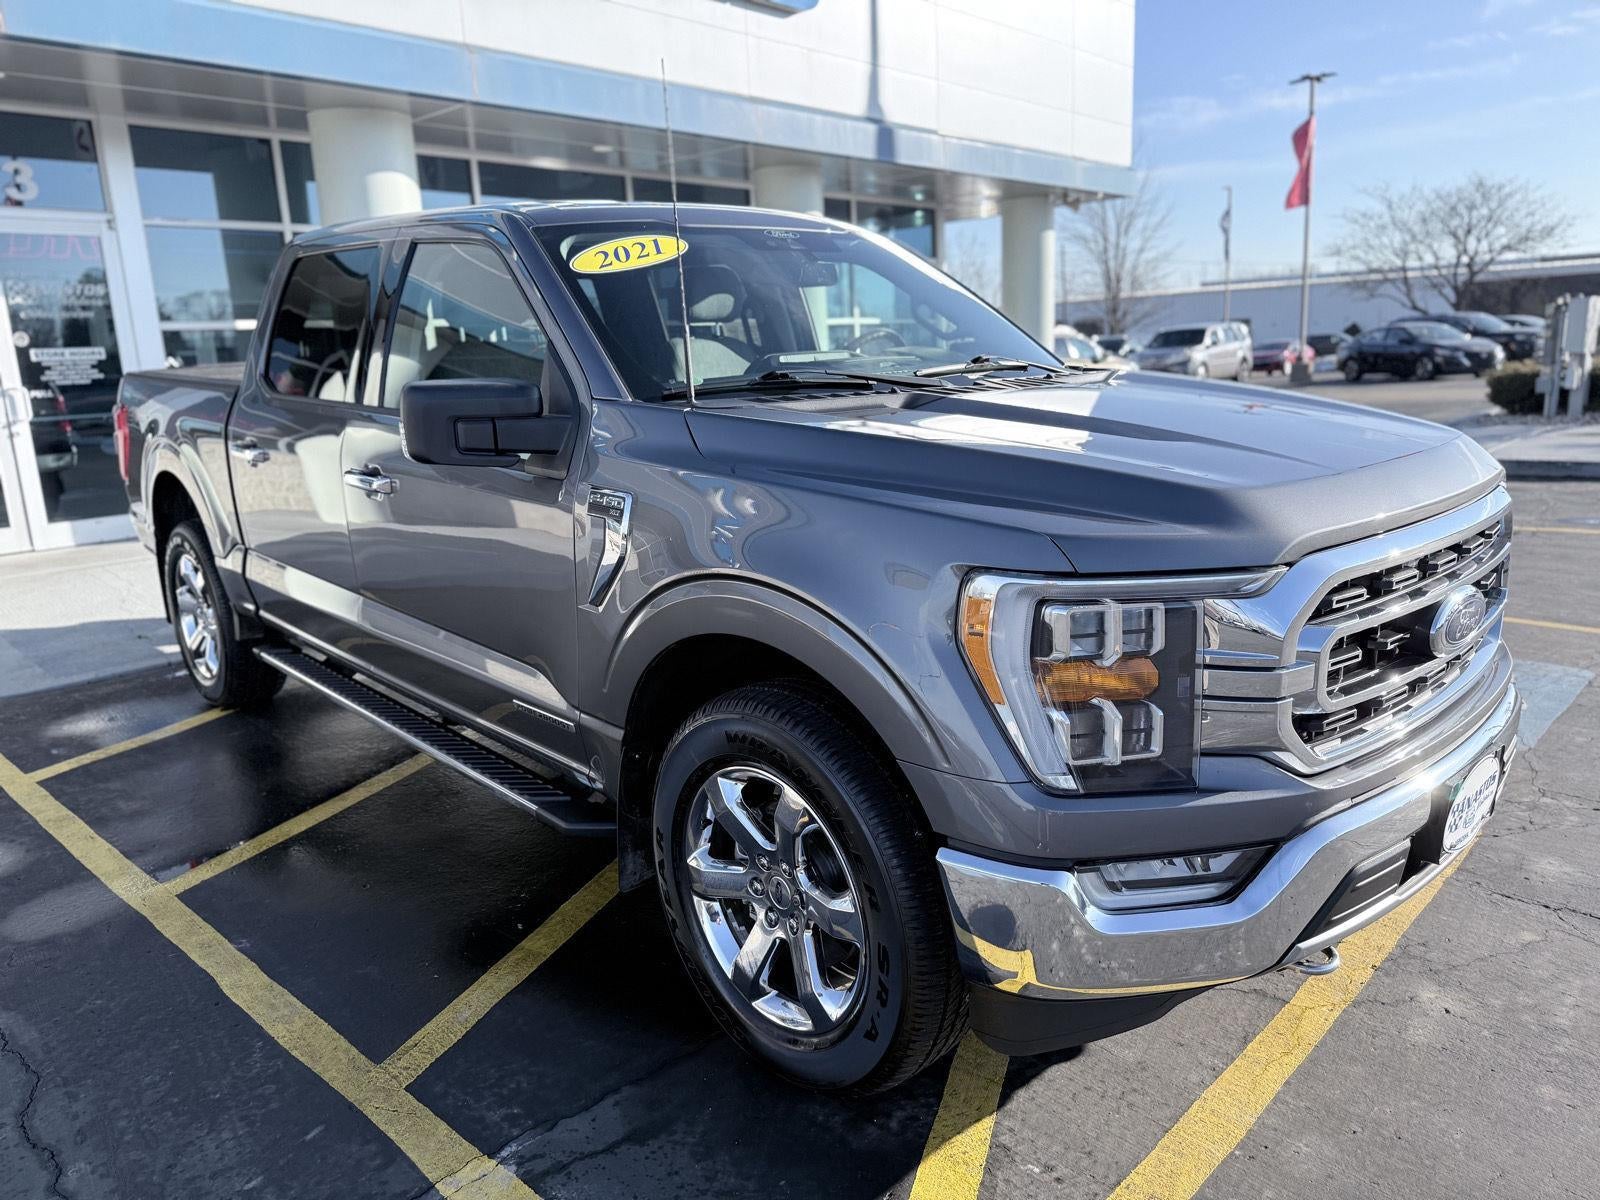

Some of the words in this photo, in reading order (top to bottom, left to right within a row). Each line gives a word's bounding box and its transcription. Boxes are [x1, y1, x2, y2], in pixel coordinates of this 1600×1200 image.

[2, 161, 39, 200] 3
[594, 239, 664, 269] 2021
[590, 493, 624, 509] F-150
[1456, 606, 1481, 640] Ford
